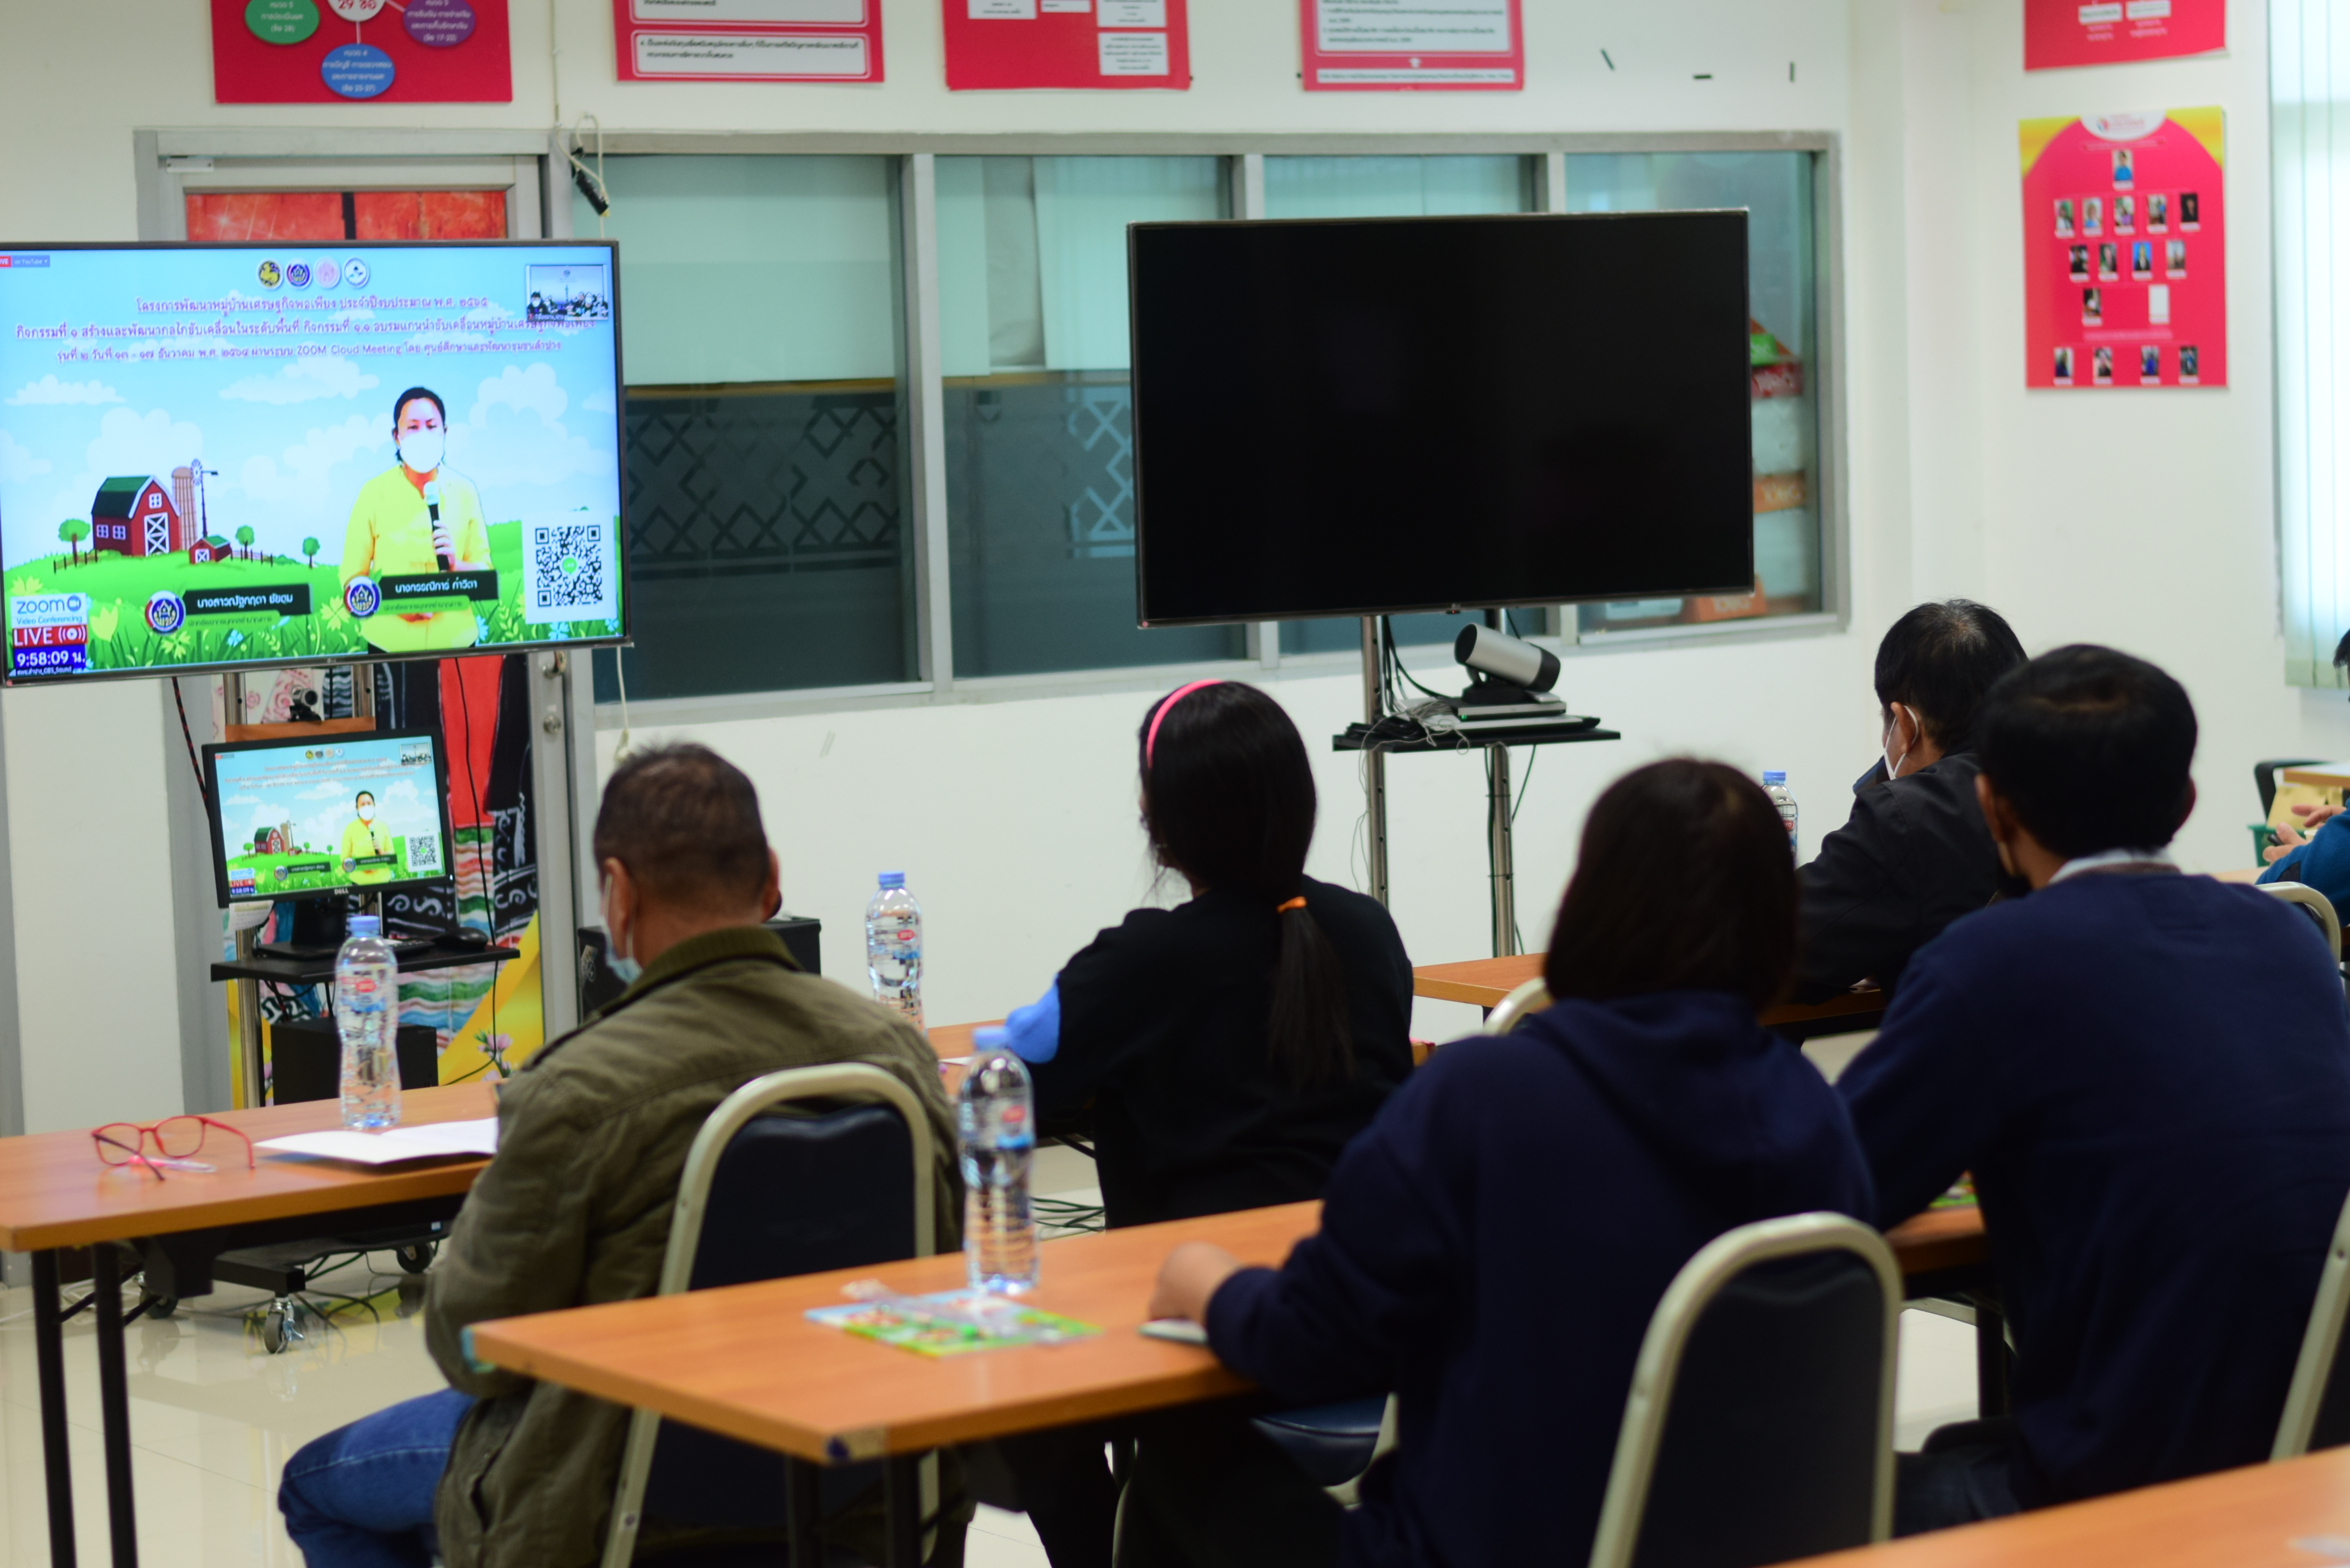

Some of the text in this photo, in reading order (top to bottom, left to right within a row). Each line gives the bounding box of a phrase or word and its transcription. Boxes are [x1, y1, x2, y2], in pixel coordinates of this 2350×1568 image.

[16, 321, 67, 339] กิจกรรมที่
[70, 330, 78, 339] ๑
[304, 316, 350, 333] กิจกรรมที่
[57, 345, 77, 364] รุ่นที่
[91, 345, 113, 361] วันที่
[158, 347, 194, 359] ธันวาคม
[251, 345, 293, 356] ผ่านระบบ
[296, 345, 326, 355] ZOOM
[330, 344, 360, 355] Cloud
[363, 344, 401, 356] Meeting
[403, 341, 421, 353] โดย
[16, 599, 65, 614] zoom
[38, 615, 83, 624] Conferencing
[13, 627, 53, 647] LIVE
[17, 650, 86, 667] 9:58:09 น.
